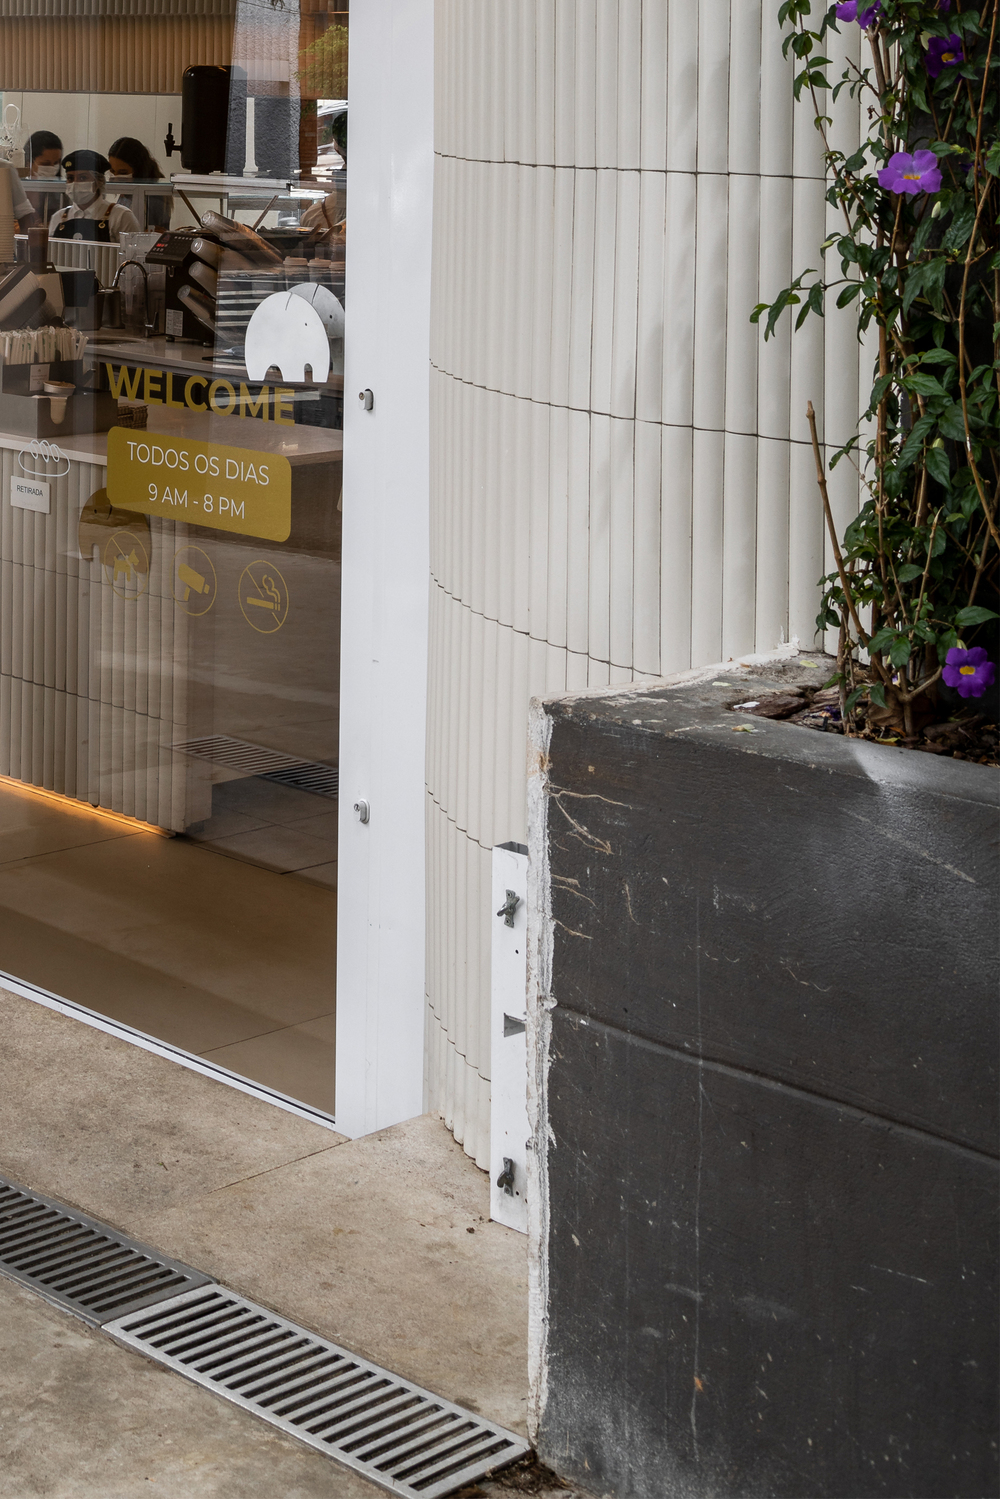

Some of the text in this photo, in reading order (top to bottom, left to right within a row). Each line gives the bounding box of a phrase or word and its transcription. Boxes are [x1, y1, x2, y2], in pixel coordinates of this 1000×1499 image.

[106, 363, 295, 427] WELCOME
[127, 441, 270, 486] TODOS OS DIAS
[16, 484, 44, 497] RETIRADA
[148, 483, 158, 501] 9
[161, 486, 188, 508] AM
[203, 493, 214, 513] 8
[219, 496, 245, 520] PM
